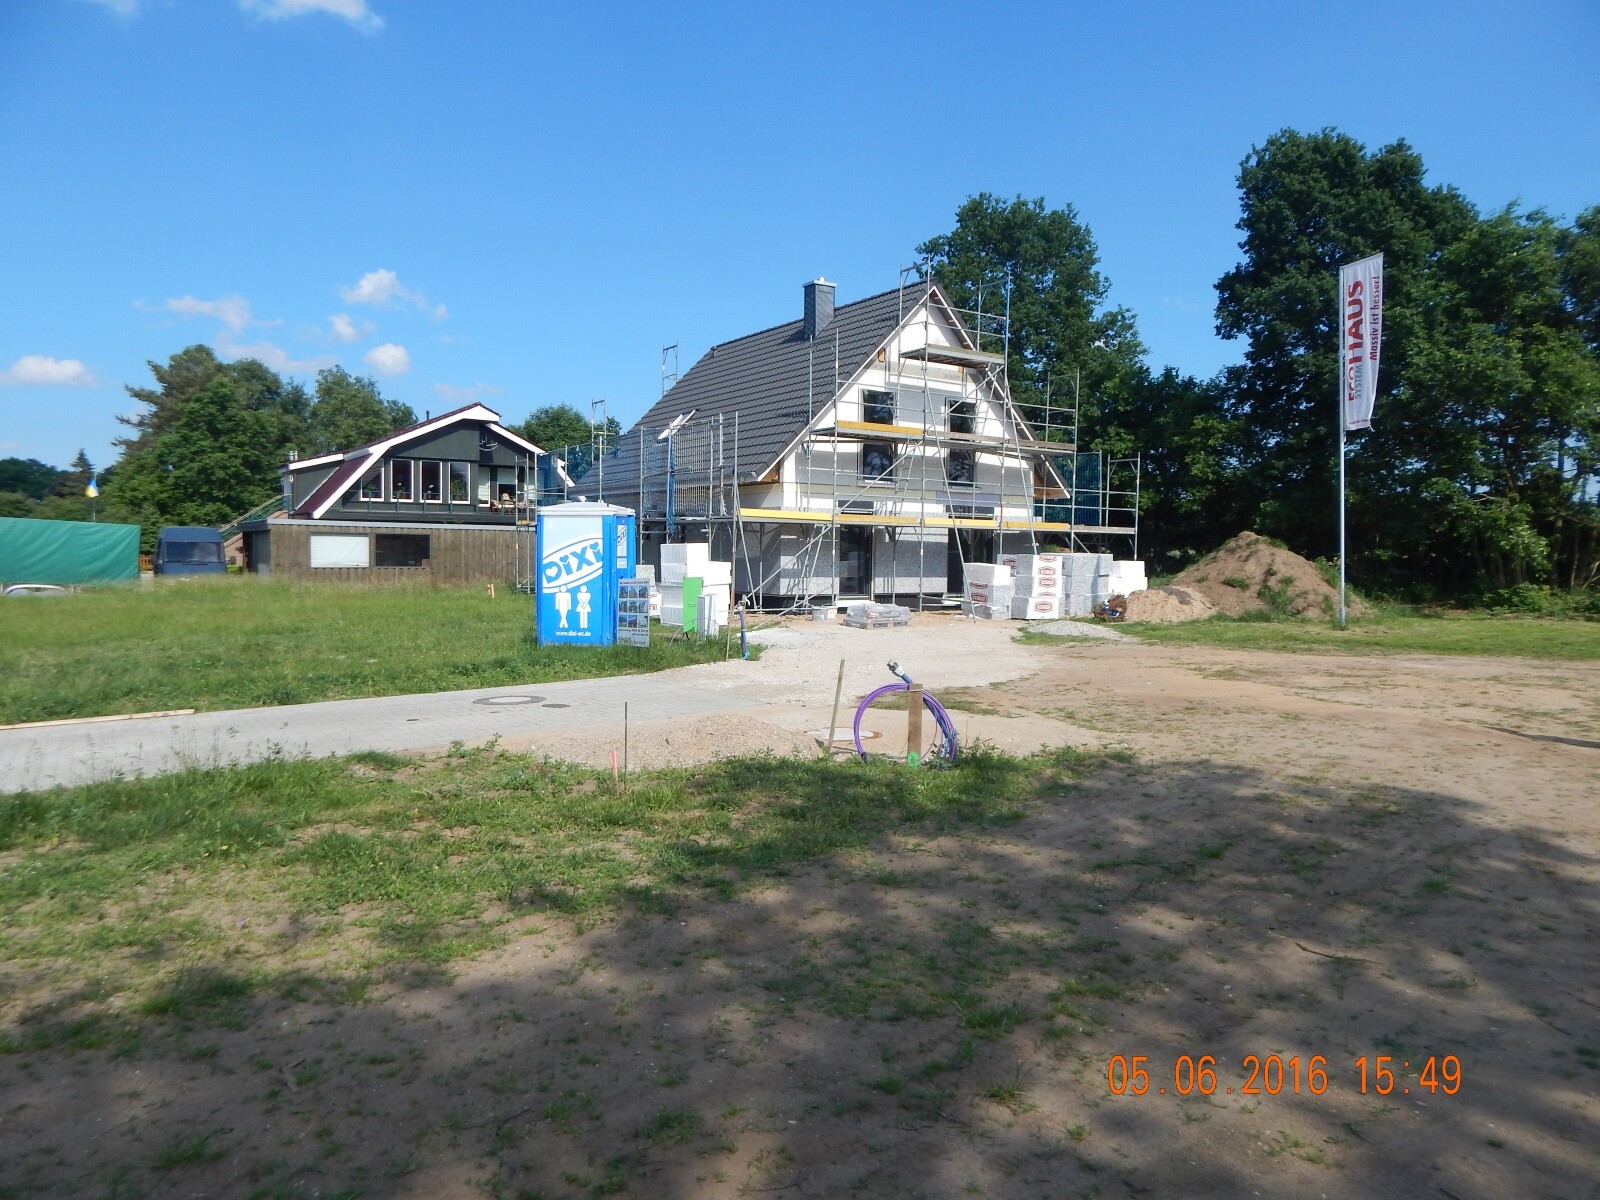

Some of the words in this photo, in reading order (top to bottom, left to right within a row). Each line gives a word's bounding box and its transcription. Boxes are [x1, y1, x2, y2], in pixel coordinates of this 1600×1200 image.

[1370, 276, 1380, 310] besser!
[1371, 313, 1380, 325] ist
[1369, 328, 1379, 361] Massiv
[1354, 364, 1363, 399] SYSTEM
